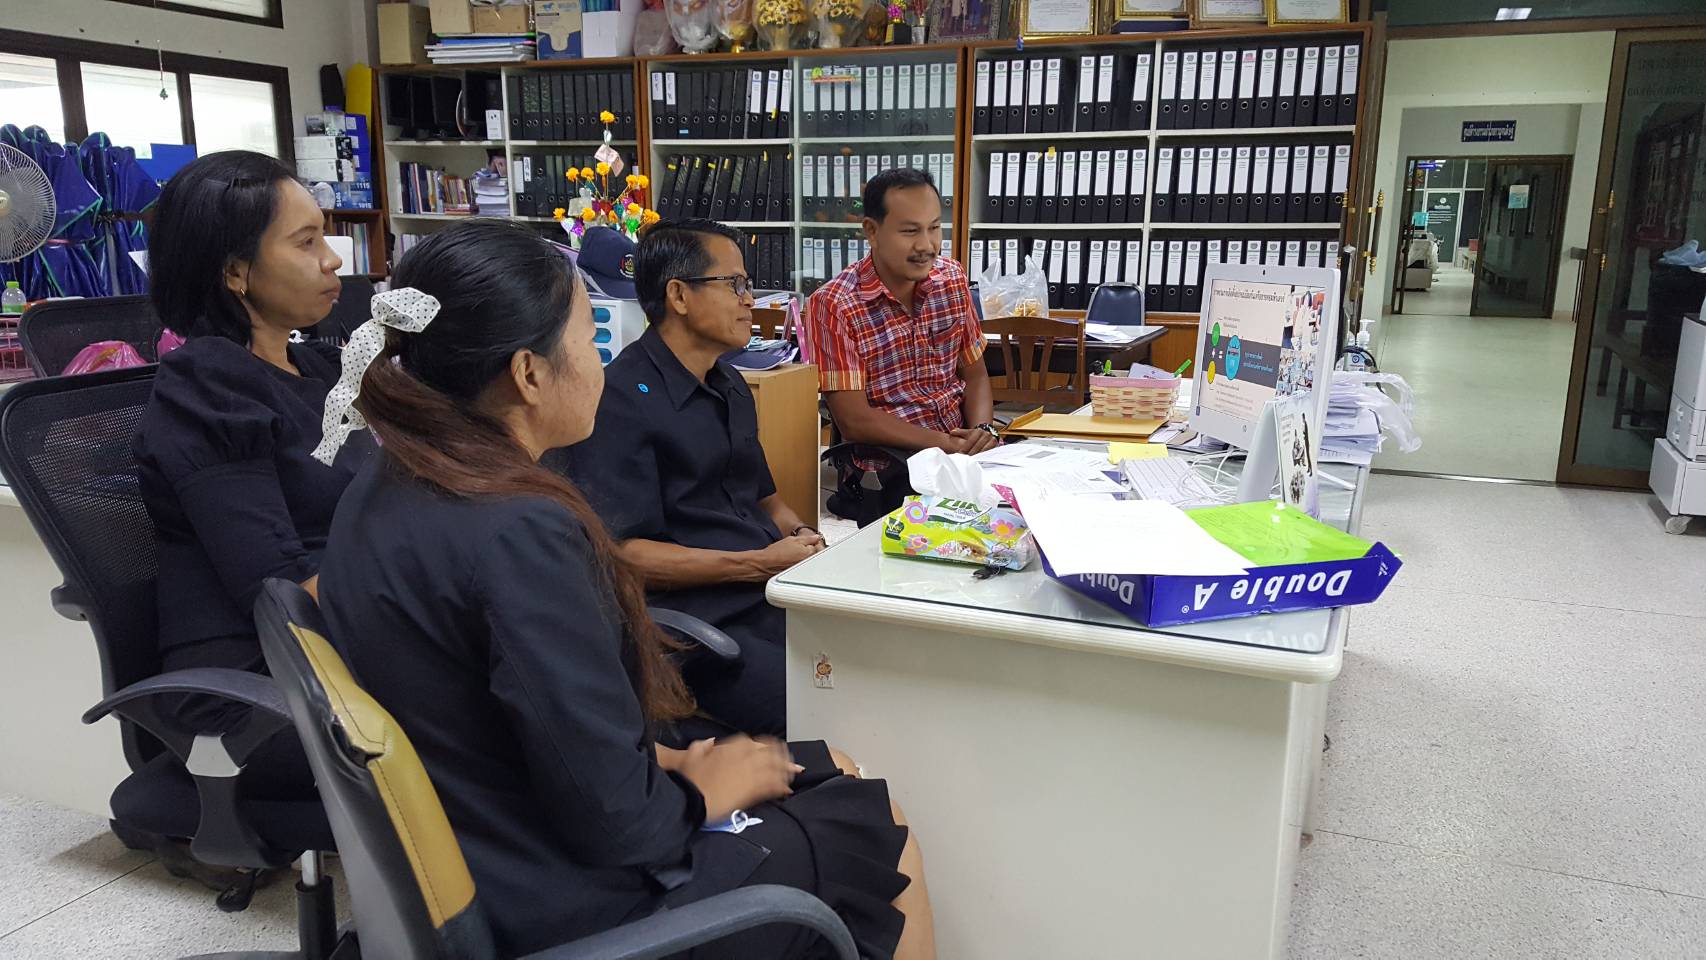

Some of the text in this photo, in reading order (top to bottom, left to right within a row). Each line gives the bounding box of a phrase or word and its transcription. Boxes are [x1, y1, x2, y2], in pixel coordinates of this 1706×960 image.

[1079, 573, 1135, 605] Doubl
[1194, 569, 1353, 610] Double A
